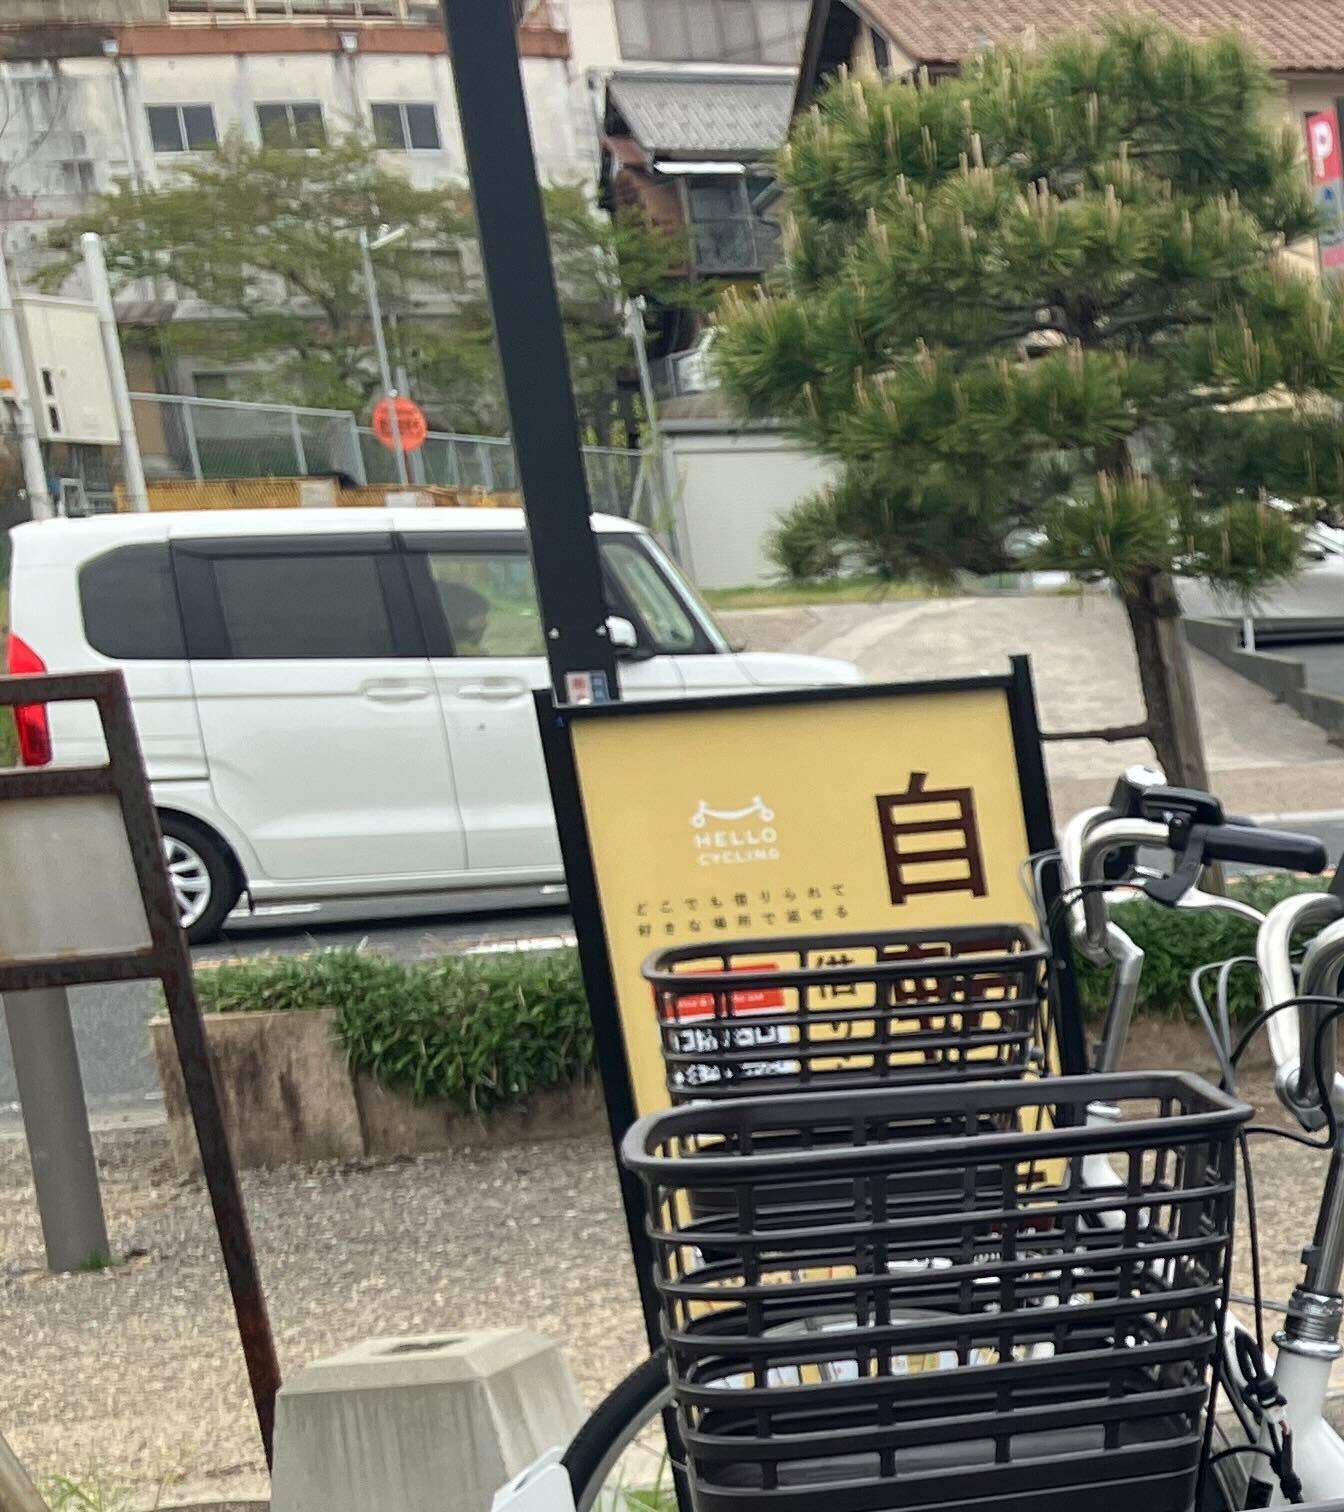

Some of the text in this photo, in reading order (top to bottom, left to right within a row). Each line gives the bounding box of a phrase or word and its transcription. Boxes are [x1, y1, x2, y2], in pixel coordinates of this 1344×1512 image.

[693, 827, 778, 849] HELLO
[696, 847, 781, 867] CYCLING
[635, 883, 846, 917] どこでも借りられて
[638, 904, 848, 938] 好きな場所で返せる
